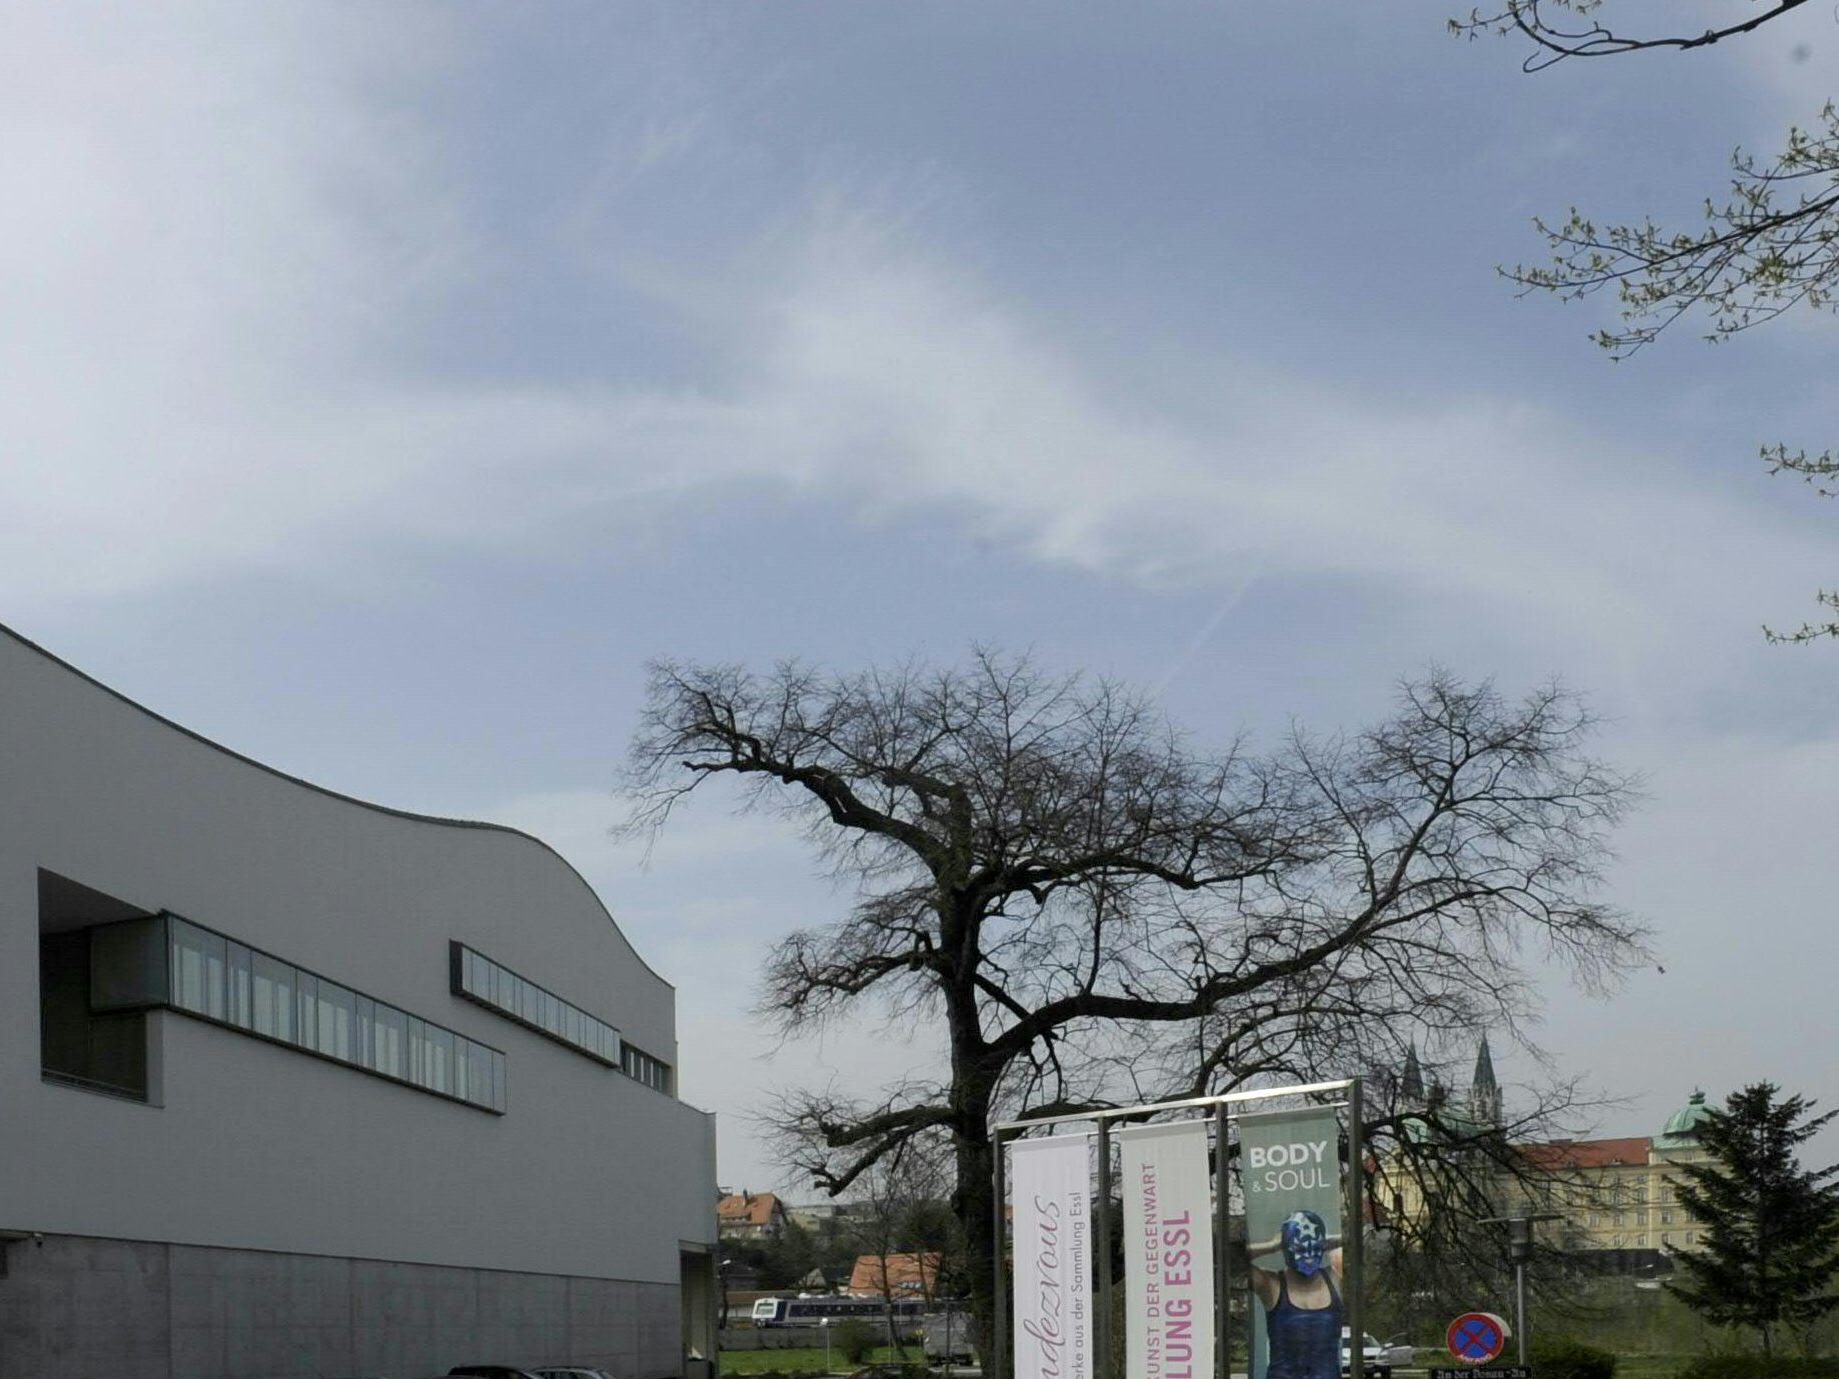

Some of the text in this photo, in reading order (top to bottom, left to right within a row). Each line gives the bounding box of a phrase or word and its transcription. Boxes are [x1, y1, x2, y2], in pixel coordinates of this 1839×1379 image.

[1250, 1141, 1327, 1168] BODY
[1252, 1167, 1331, 1192] & SOUL
[1069, 1192, 1083, 1216] Essl
[1142, 1163, 1159, 1275] GEGENWART
[1070, 1222, 1085, 1292] Sammlung
[1162, 1210, 1192, 1286] ESSL
[1071, 1298, 1084, 1319] der
[1146, 1283, 1159, 1318] DER
[1073, 1325, 1084, 1348] aus
